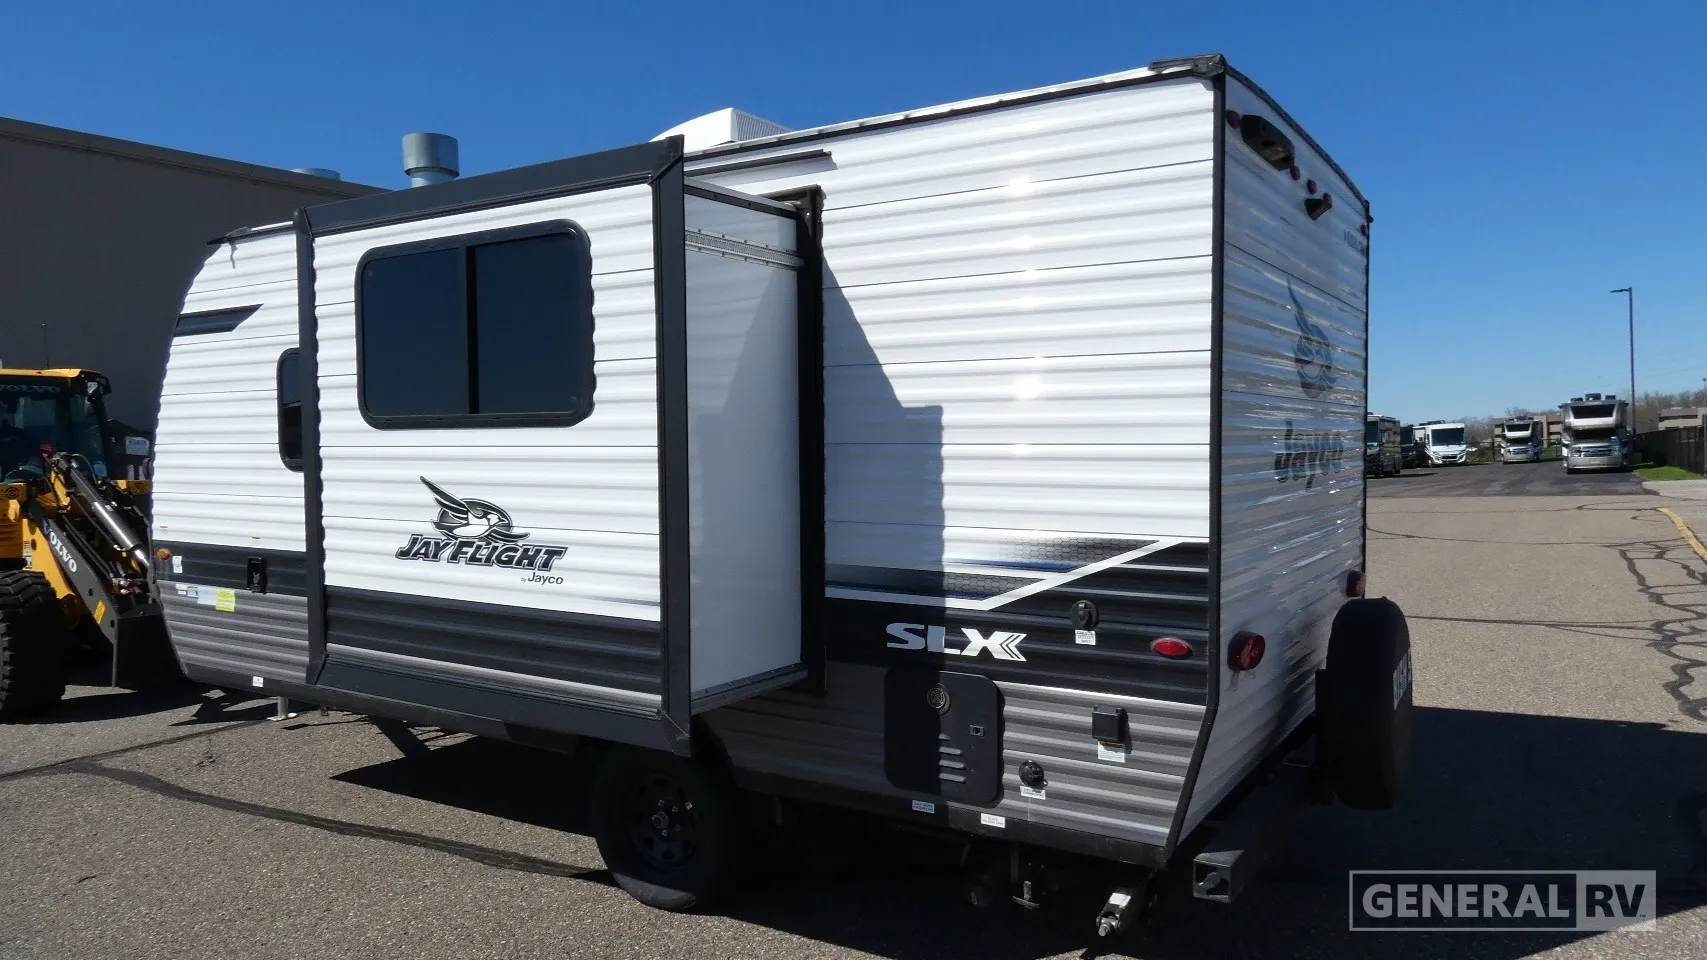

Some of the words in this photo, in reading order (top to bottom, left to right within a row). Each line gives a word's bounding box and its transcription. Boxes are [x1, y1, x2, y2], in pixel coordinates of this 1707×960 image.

[1274, 418, 1344, 491] Jayco
[42, 518, 77, 573] VOLVO
[395, 533, 454, 562] JAY
[447, 538, 568, 572] FLIGHT
[528, 572, 564, 585] Jayco
[885, 622, 1027, 662] SLX
